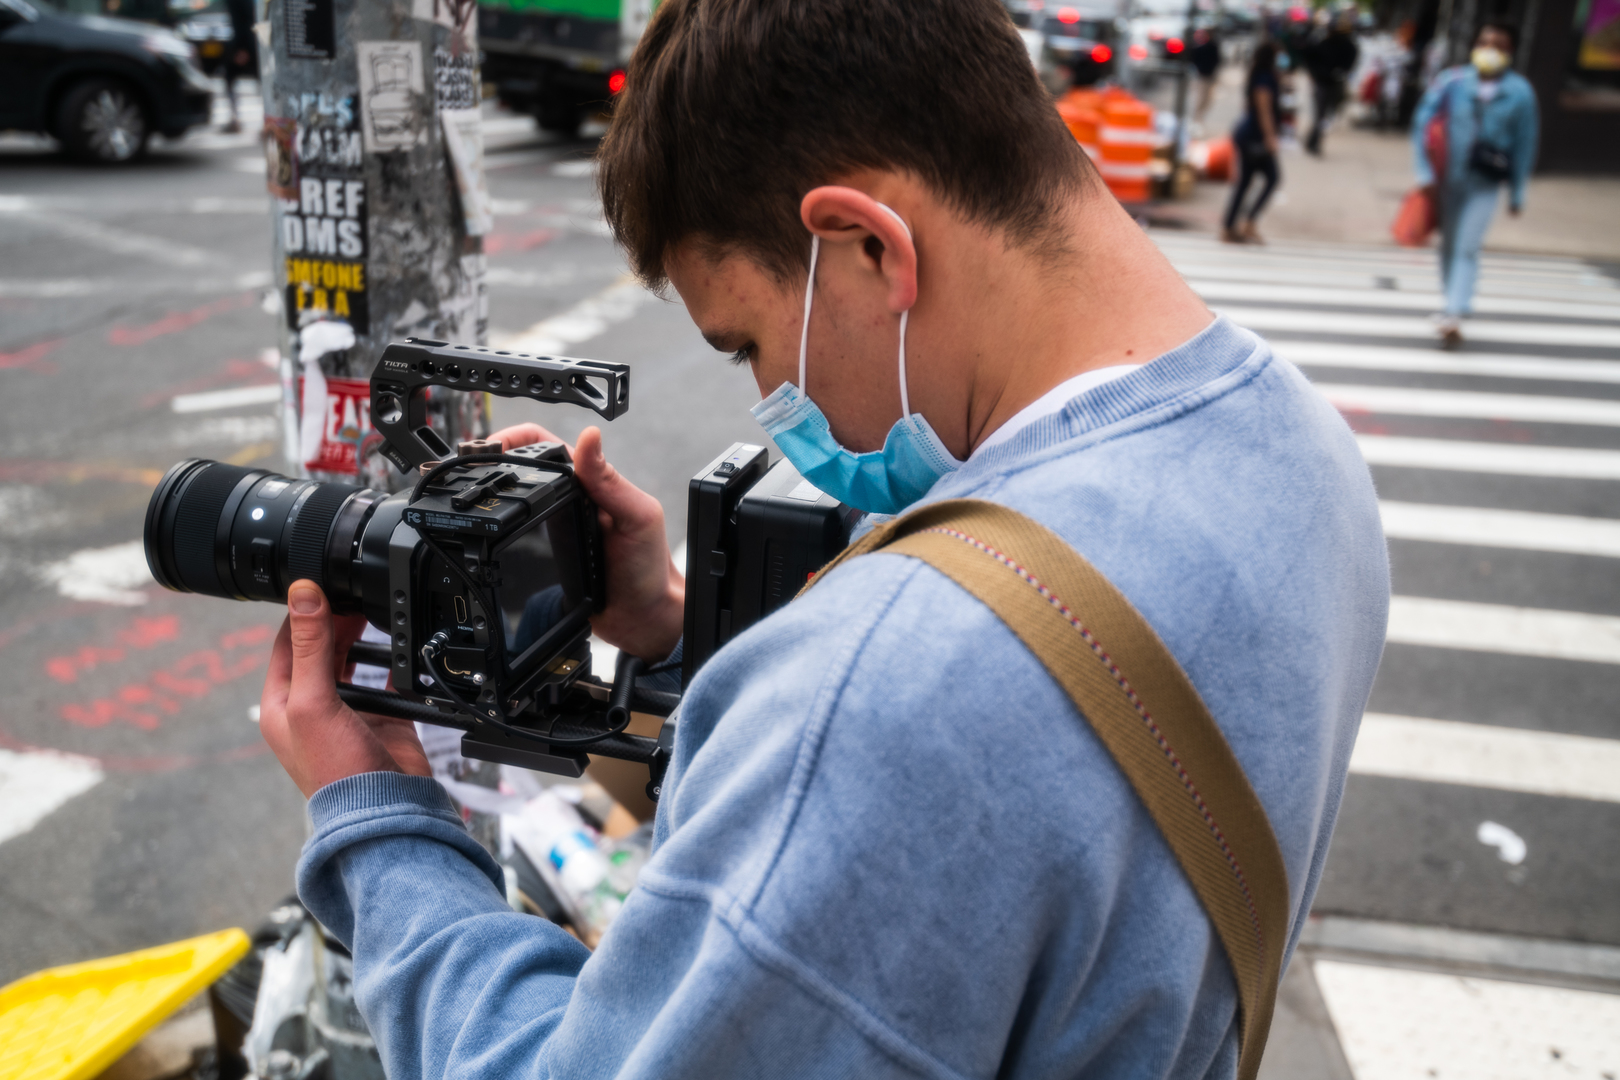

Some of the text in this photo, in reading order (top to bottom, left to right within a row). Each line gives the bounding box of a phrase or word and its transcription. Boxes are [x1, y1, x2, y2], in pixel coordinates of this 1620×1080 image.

[283, 214, 363, 258] DMS
[384, 360, 409, 369] TILTA
[489, 524, 499, 532] TB
